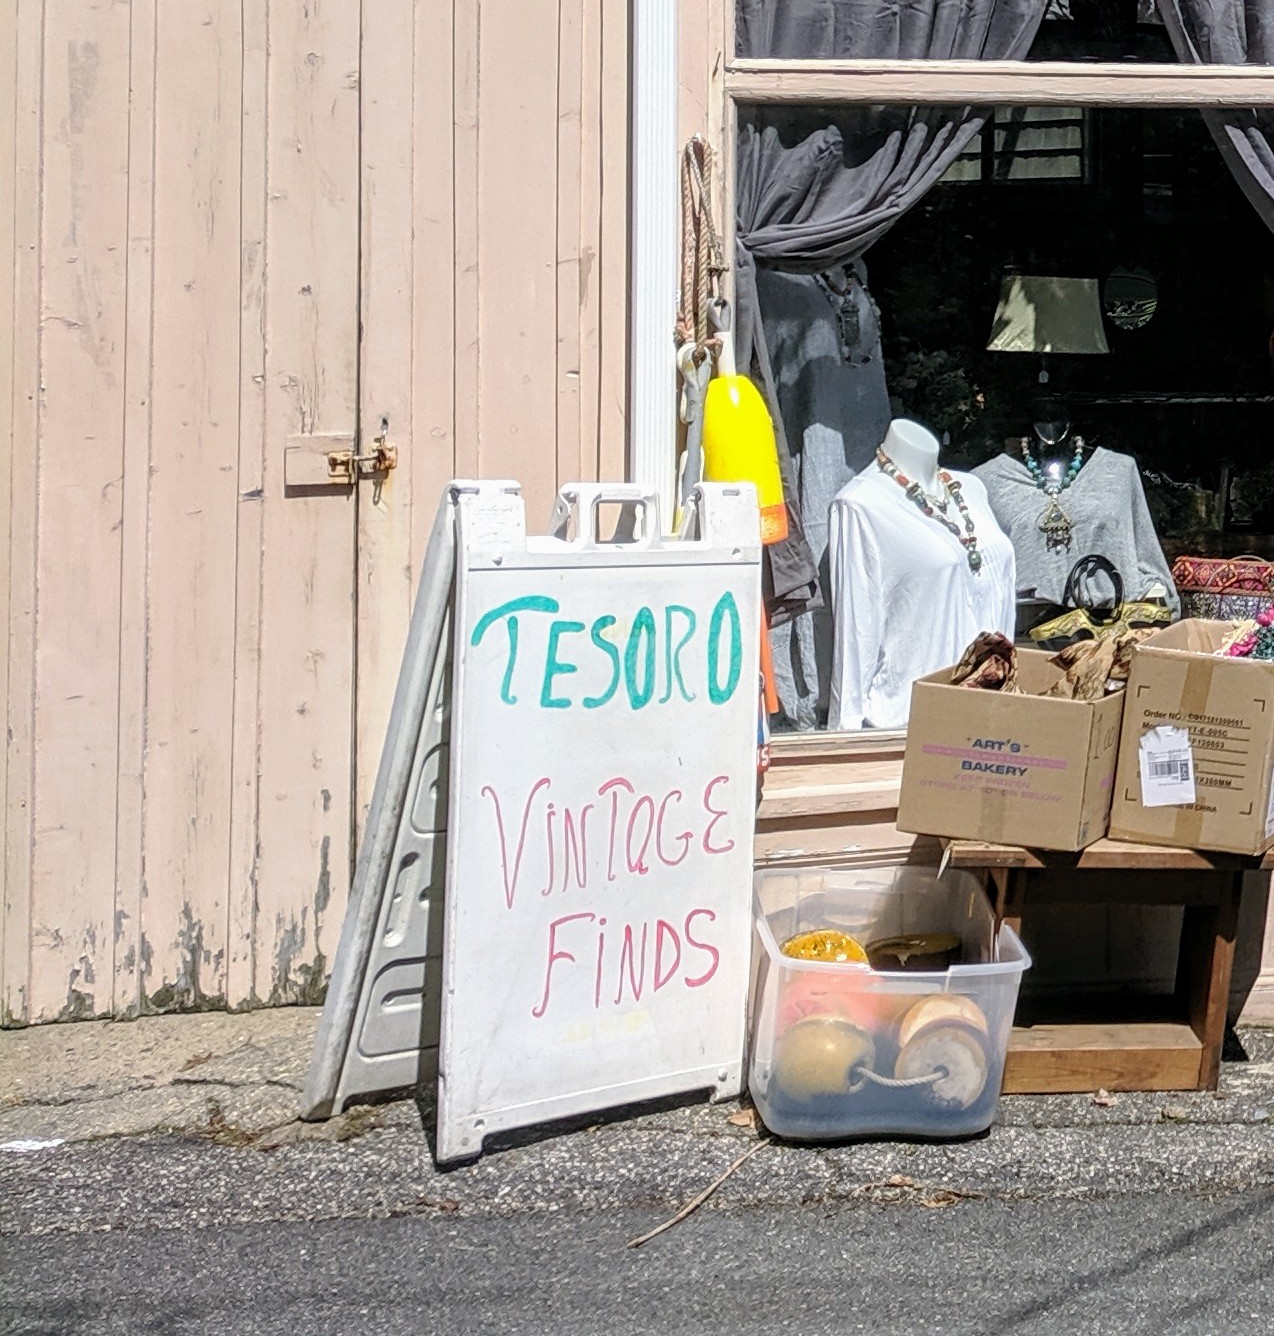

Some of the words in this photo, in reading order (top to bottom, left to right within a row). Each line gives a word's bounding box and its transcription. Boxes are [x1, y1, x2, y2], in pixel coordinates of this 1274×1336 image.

[470, 591, 743, 710] TESORO
[1143, 709, 1166, 719] Order
[961, 760, 1028, 776] BAKERY
